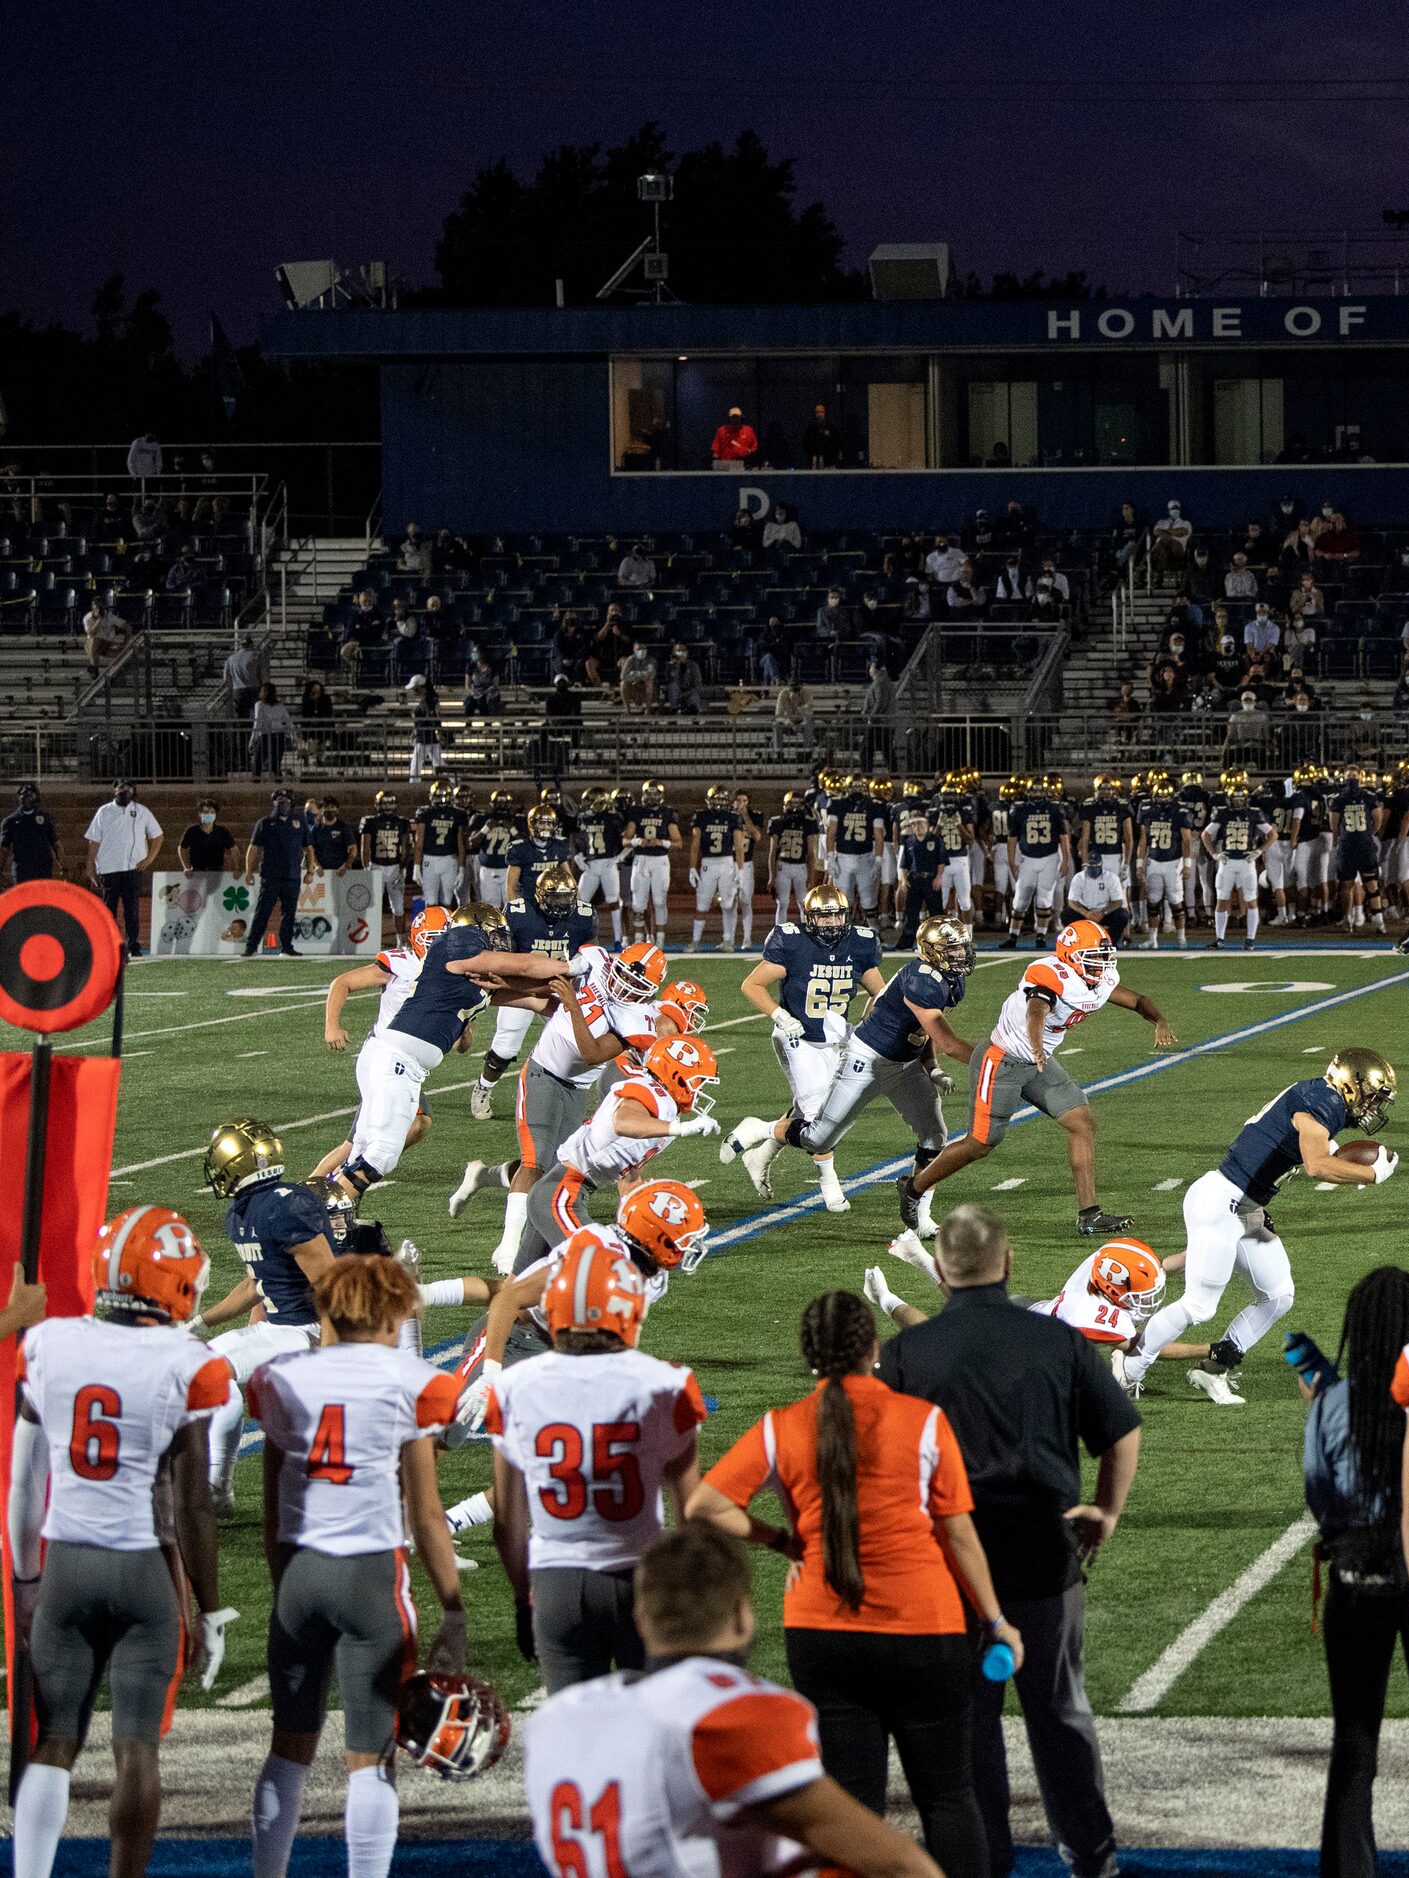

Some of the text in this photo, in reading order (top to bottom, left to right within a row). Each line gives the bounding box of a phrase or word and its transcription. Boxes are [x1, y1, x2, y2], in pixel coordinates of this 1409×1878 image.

[1047, 310, 1242, 341] HOME
[1284, 305, 1366, 336] OF
[739, 487, 770, 520] D
[436, 827, 449, 846] 7
[486, 832, 511, 855] 77
[587, 832, 606, 855] 14
[709, 832, 723, 854] 3
[843, 820, 867, 842] 75
[1026, 821, 1052, 845] 63
[1094, 822, 1118, 845] 85
[1150, 828, 1172, 850] 70
[780, 837, 803, 860] 26
[531, 860, 560, 872] JESUIT
[531, 939, 570, 951] JESUIT
[809, 964, 853, 978] JESUIT
[579, 984, 606, 1026] 71
[804, 978, 854, 1019] 65
[666, 1039, 701, 1067] R
[648, 1192, 689, 1225] R
[153, 1222, 198, 1259] R
[1099, 1257, 1131, 1286] R
[1095, 1304, 1119, 1329] 24
[69, 1384, 123, 1482] 6
[307, 1403, 354, 1485] 4
[534, 1421, 645, 1521] 35
[550, 1777, 629, 1878] 61
